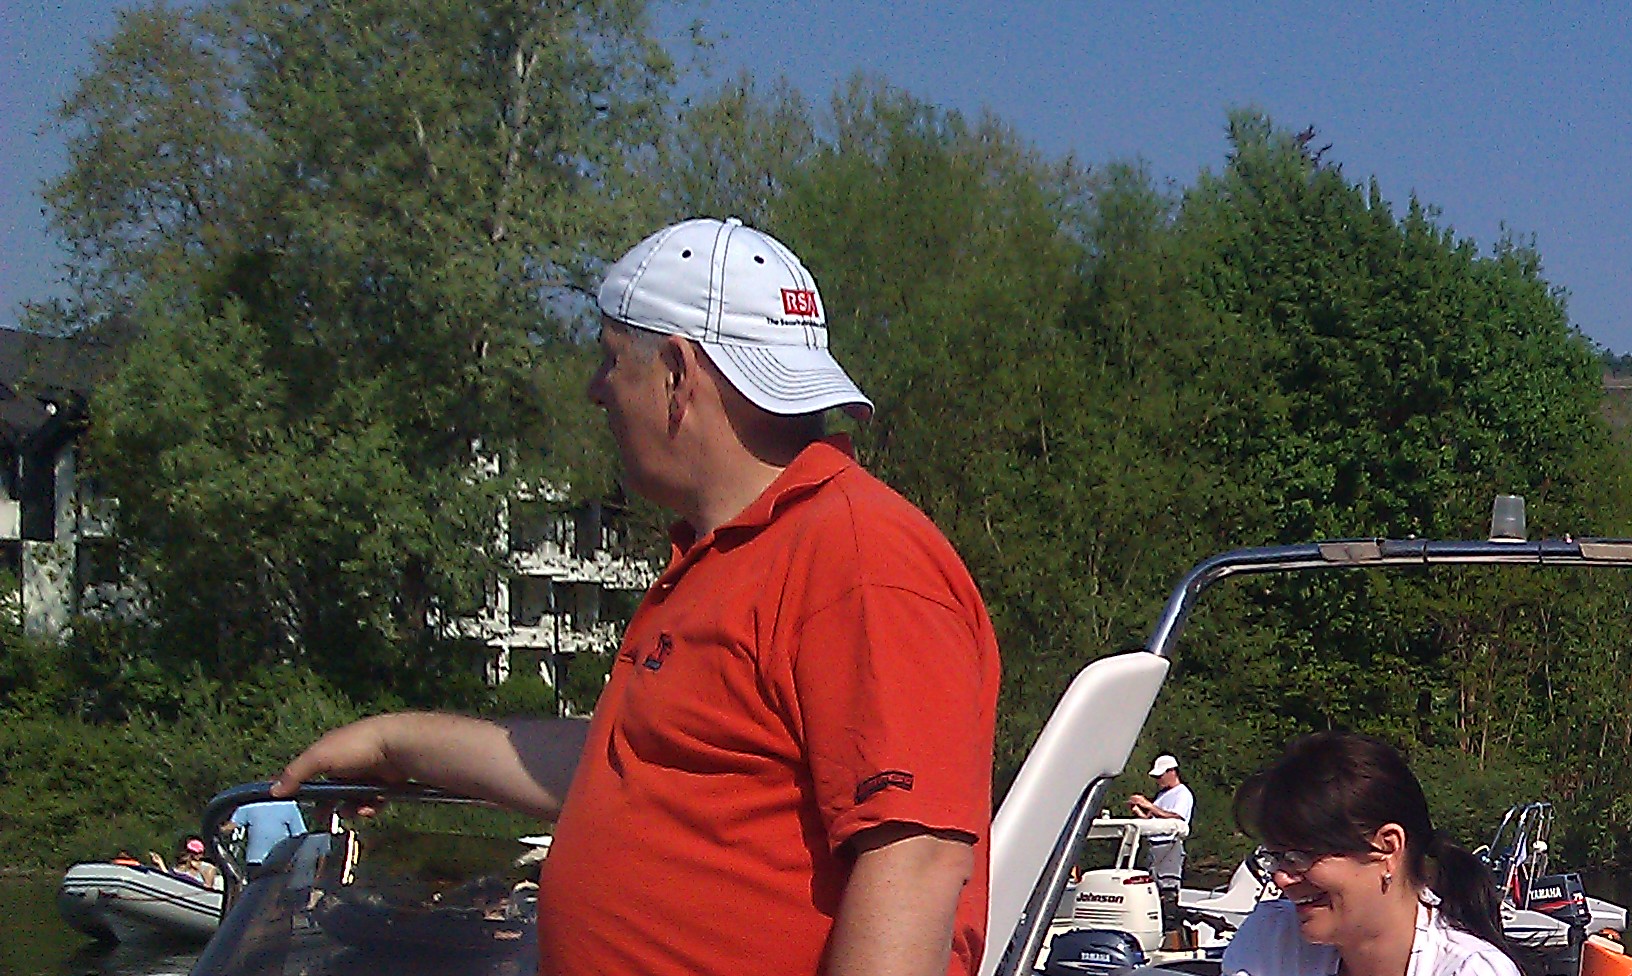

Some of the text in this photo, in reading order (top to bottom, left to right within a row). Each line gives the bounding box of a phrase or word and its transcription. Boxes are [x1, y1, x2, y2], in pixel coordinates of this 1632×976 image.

[785, 291, 817, 314] RSA
[1076, 892, 1124, 904] Johnson
[1530, 886, 1563, 900] YAMAHA
